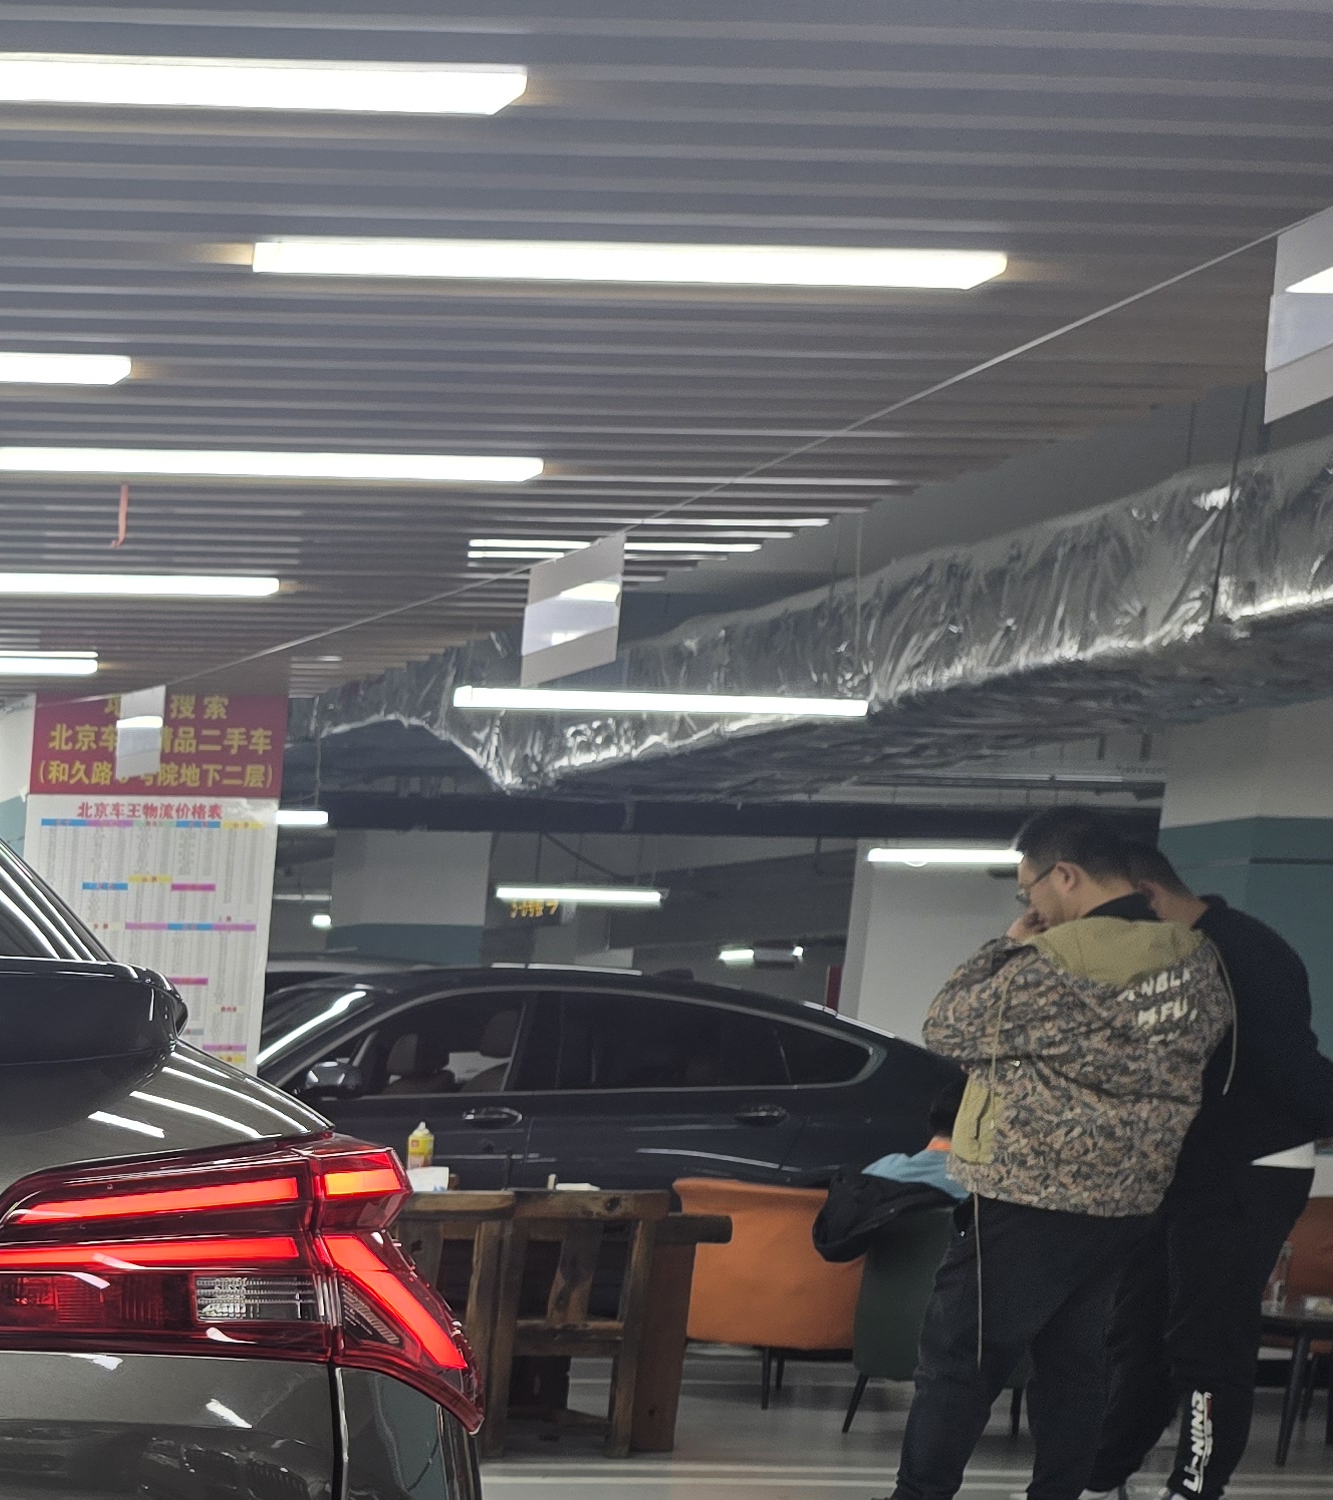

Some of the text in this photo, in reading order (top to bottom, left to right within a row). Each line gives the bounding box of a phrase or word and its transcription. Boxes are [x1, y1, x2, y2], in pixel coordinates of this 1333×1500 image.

[77, 801, 224, 820] 北京车王物流价格表
